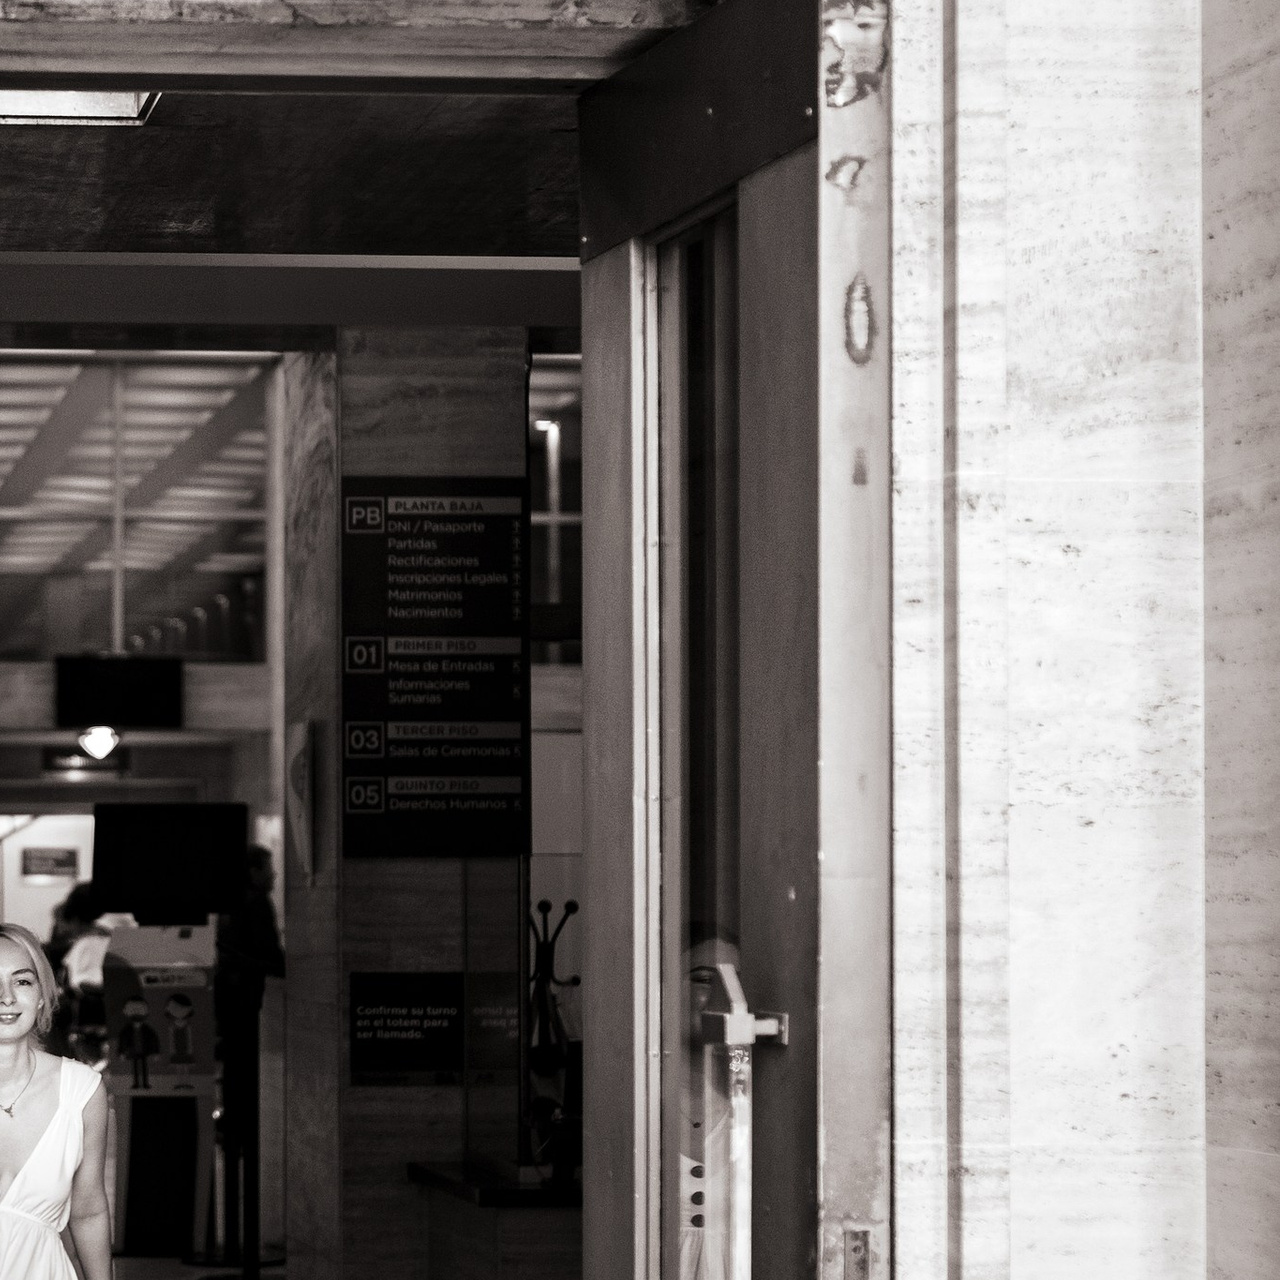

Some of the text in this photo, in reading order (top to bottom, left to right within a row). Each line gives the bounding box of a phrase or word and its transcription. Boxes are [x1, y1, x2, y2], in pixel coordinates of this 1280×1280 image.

[395, 502, 484, 511] PLANTA BAJA
[352, 507, 381, 525] PB
[388, 521, 411, 533] DNI
[424, 521, 485, 536] Pasaporte
[388, 538, 438, 550] Partidas
[388, 555, 480, 566] Rectificaciones
[388, 572, 508, 586] Inscripciones Legales
[388, 589, 463, 601] Matrimonios
[388, 607, 463, 618] Nacimientos
[395, 641, 476, 651] PRIMER PISO
[353, 645, 377, 665] 01
[388, 659, 494, 672] Mesa de Entradas
[388, 678, 470, 691] Informaciones
[388, 692, 442, 704] Sumarias
[395, 725, 479, 735] TERCER PISO
[351, 730, 379, 750] 03
[389, 745, 510, 757] Salas de Ceremonias
[395, 780, 480, 791] QUINTO PISO
[351, 785, 379, 805] 05
[389, 799, 507, 810] Derechos Humanos
[356, 1005, 457, 1016] Confirme su turno
[356, 1017, 449, 1029] en el totem para
[356, 1029, 425, 1039] ser llamado.
